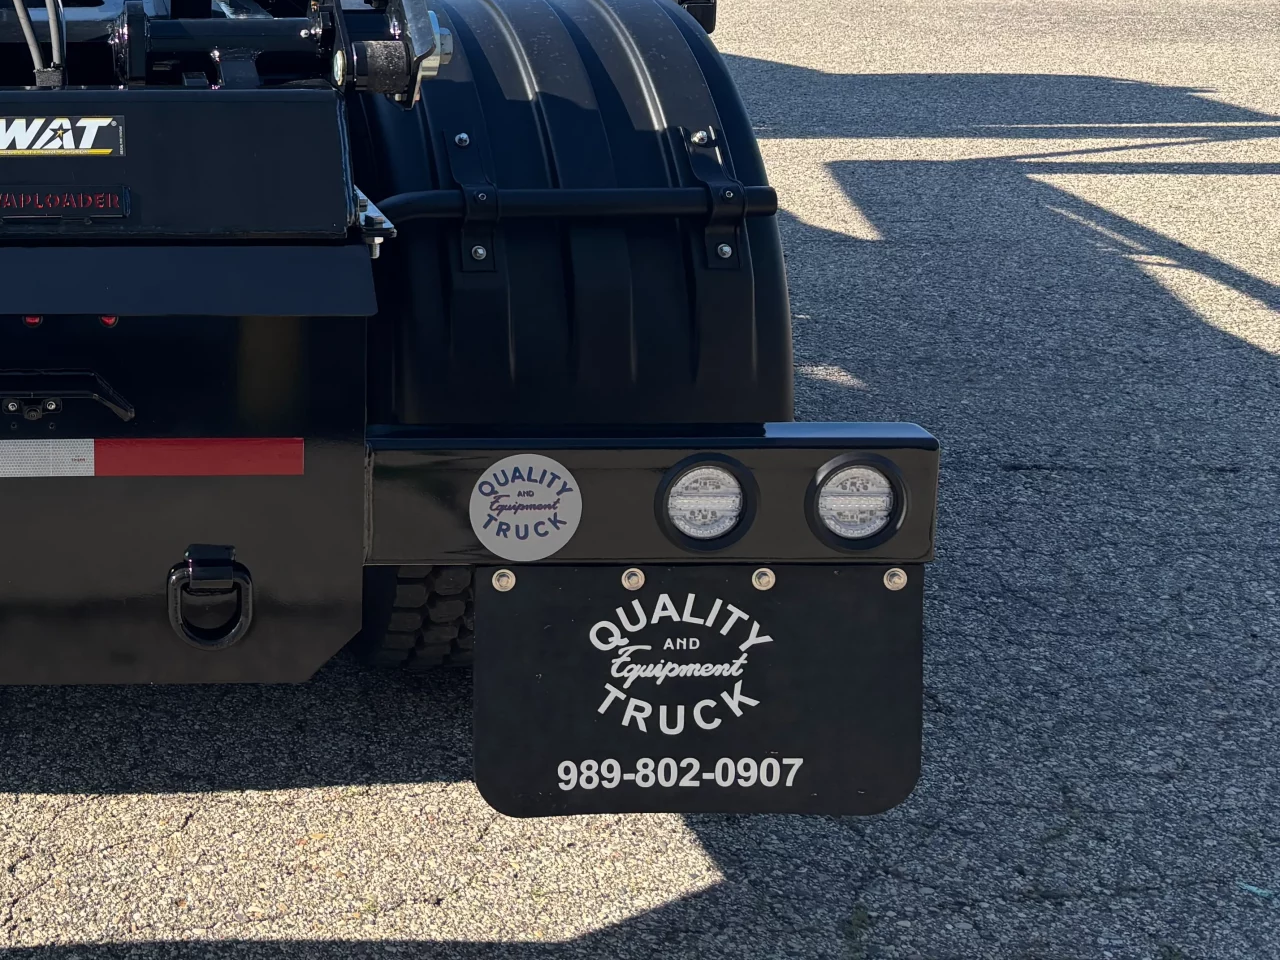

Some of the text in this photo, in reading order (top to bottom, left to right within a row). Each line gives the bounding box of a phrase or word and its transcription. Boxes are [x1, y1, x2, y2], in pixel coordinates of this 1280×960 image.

[478, 466, 573, 497] QUALITY
[489, 494, 561, 517] Equipment
[483, 512, 567, 540] TRUCK
[589, 593, 774, 652] QUALITY
[663, 637, 701, 650] AND
[610, 644, 748, 690] Equipment
[597, 679, 761, 735] TRUCK
[557, 757, 804, 791] 989-802-0907
